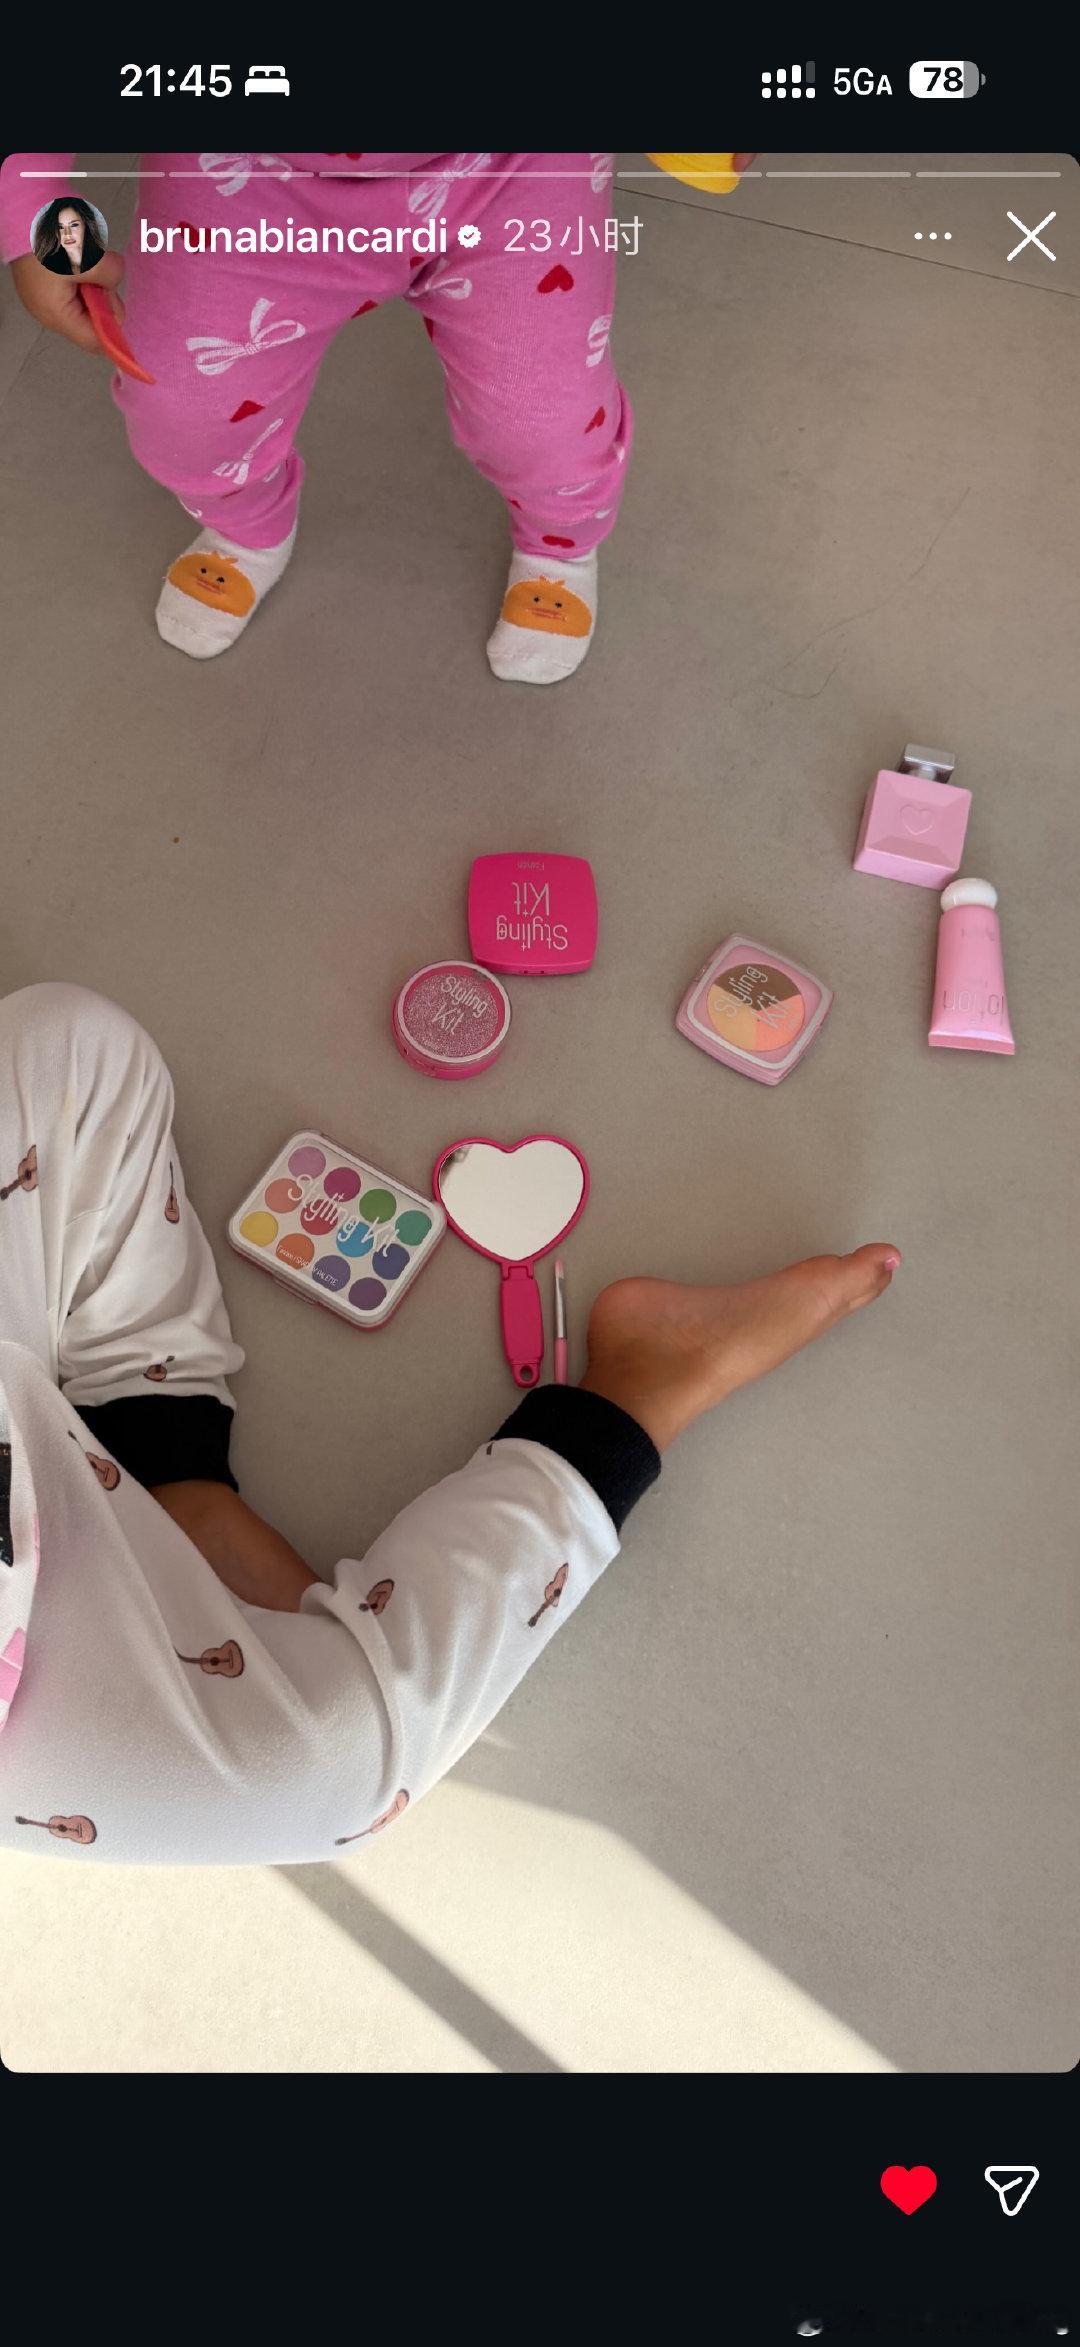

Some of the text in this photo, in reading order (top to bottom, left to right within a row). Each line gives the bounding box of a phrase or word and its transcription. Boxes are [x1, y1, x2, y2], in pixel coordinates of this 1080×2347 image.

[512, 882, 550, 917] Kit
[496, 914, 568, 952] Styling
[440, 975, 488, 1019] Styling
[714, 966, 768, 1018] Styling
[751, 991, 789, 1029] Kit
[432, 1003, 464, 1036] Kit
[287, 1173, 400, 1258] Styling Kit
